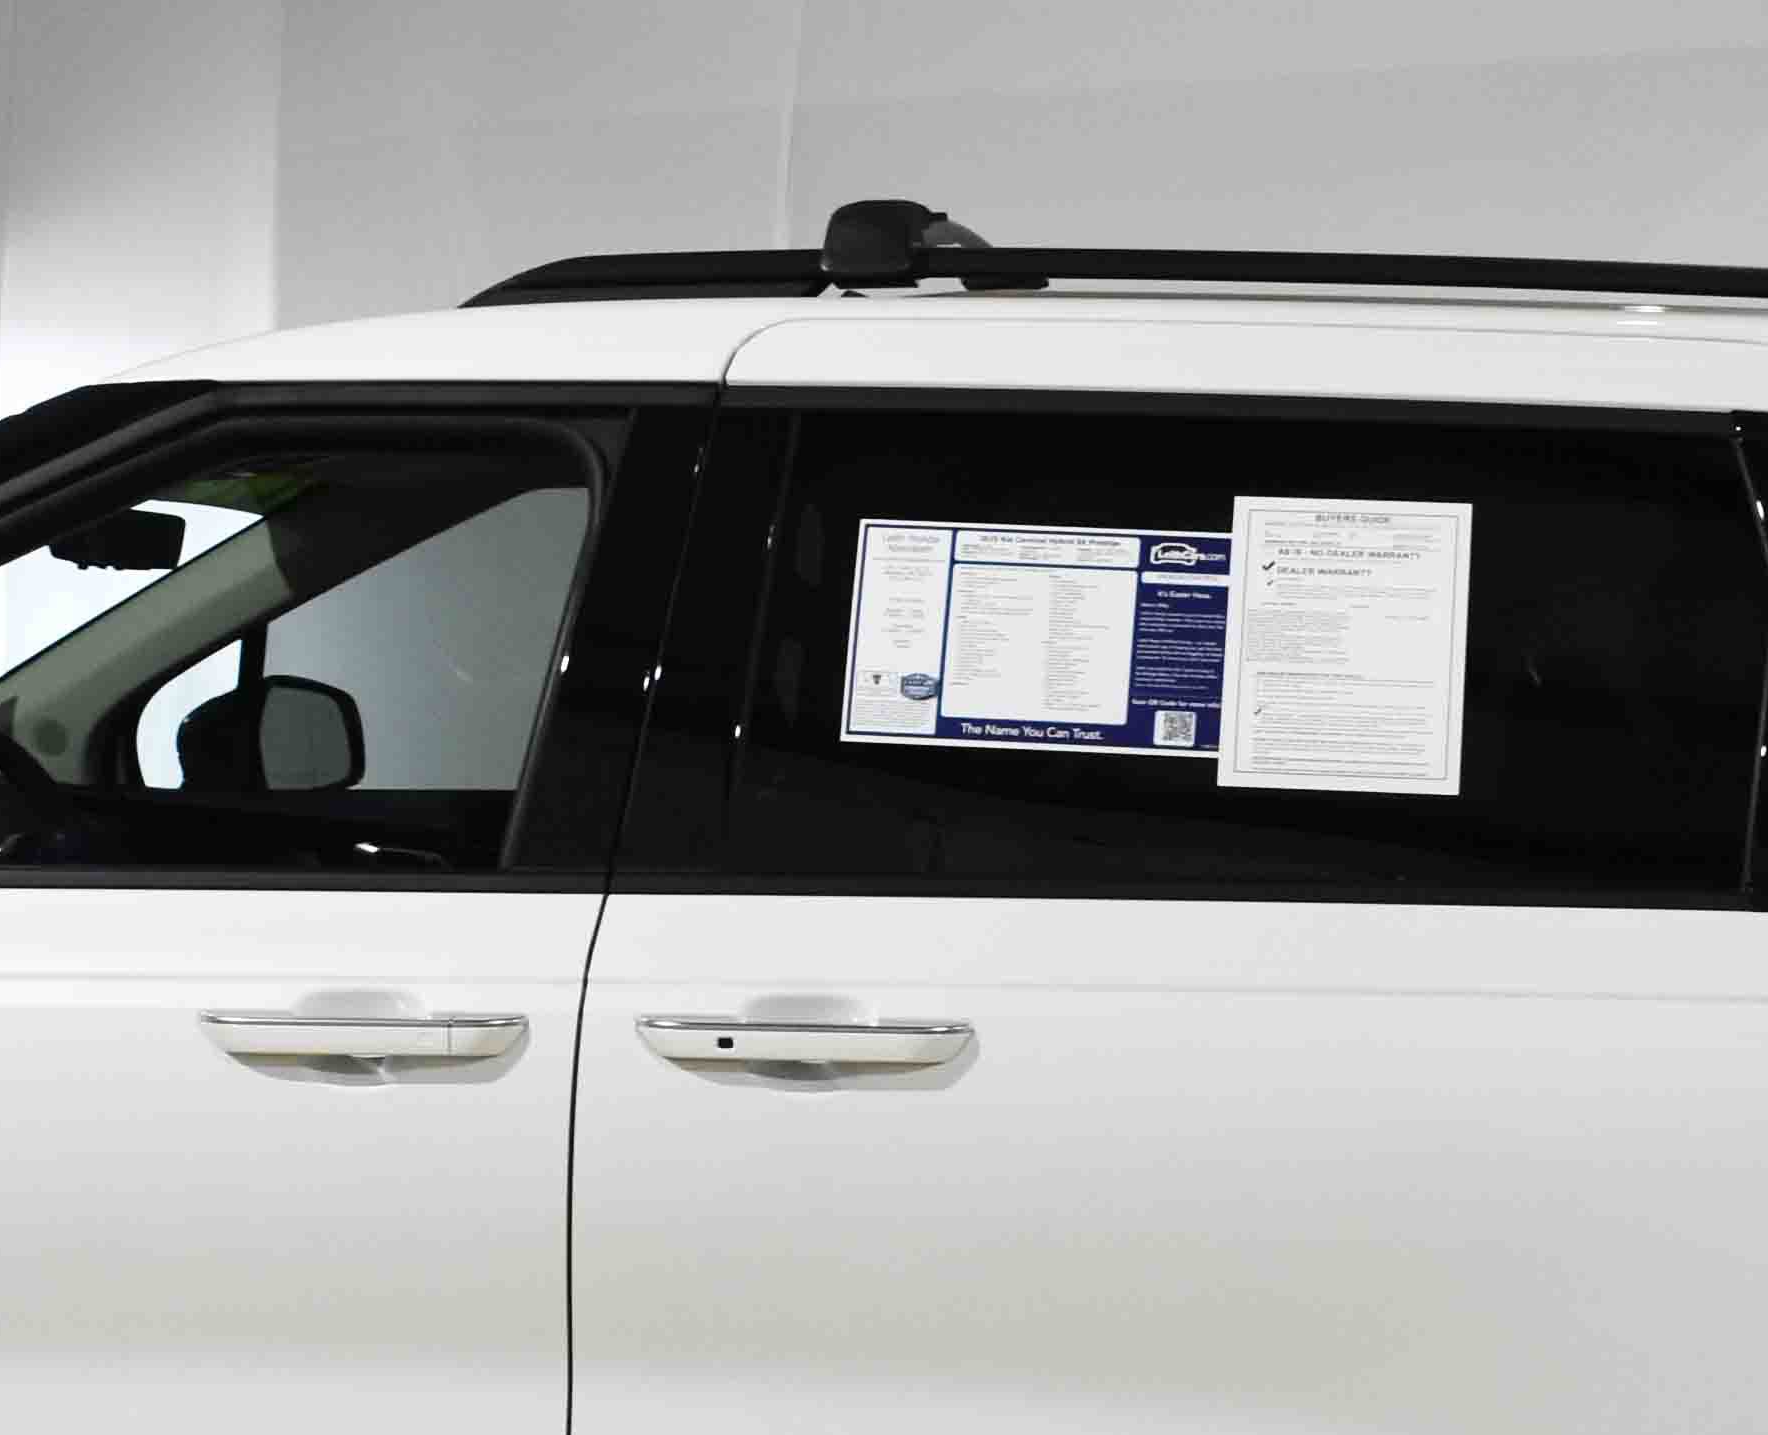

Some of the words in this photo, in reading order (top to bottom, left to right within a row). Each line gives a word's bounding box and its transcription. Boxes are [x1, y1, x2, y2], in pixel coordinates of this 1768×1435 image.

[961, 722, 982, 734] The
[985, 724, 1020, 736] Name
[1023, 726, 1044, 737] You
[1046, 727, 1069, 738] Can
[1072, 728, 1104, 740] Trust.
